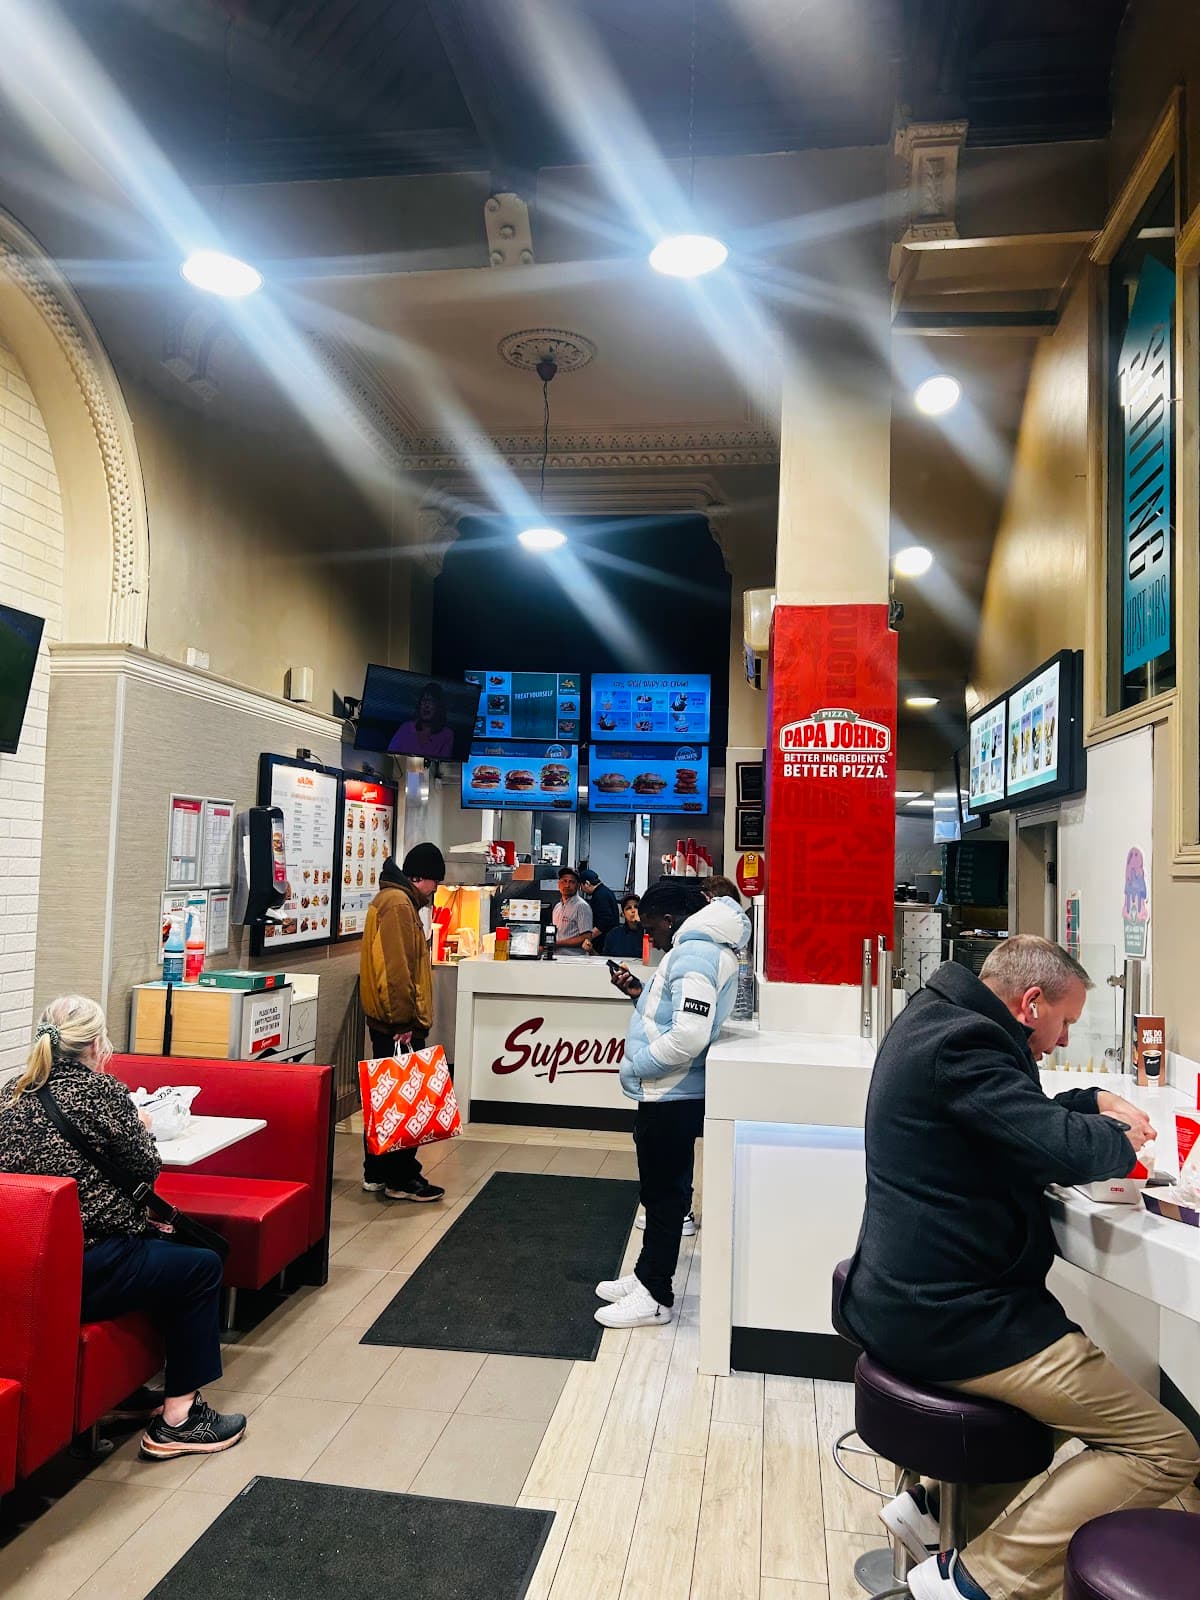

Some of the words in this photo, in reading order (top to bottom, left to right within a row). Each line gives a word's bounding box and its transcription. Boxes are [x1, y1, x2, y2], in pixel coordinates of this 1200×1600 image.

[784, 723, 828, 748] PAPA
[830, 722, 886, 748] JOHNS
[783, 753, 820, 763] BETTER
[822, 753, 888, 764] INGREDIENTS.
[783, 764, 838, 778] BETTER
[842, 764, 888, 778] PIZZA.
[684, 1001, 710, 1013] NVLTY
[1142, 1029, 1153, 1038] WE
[1154, 1029, 1163, 1038] DO
[1142, 1037, 1163, 1045] COFFEE
